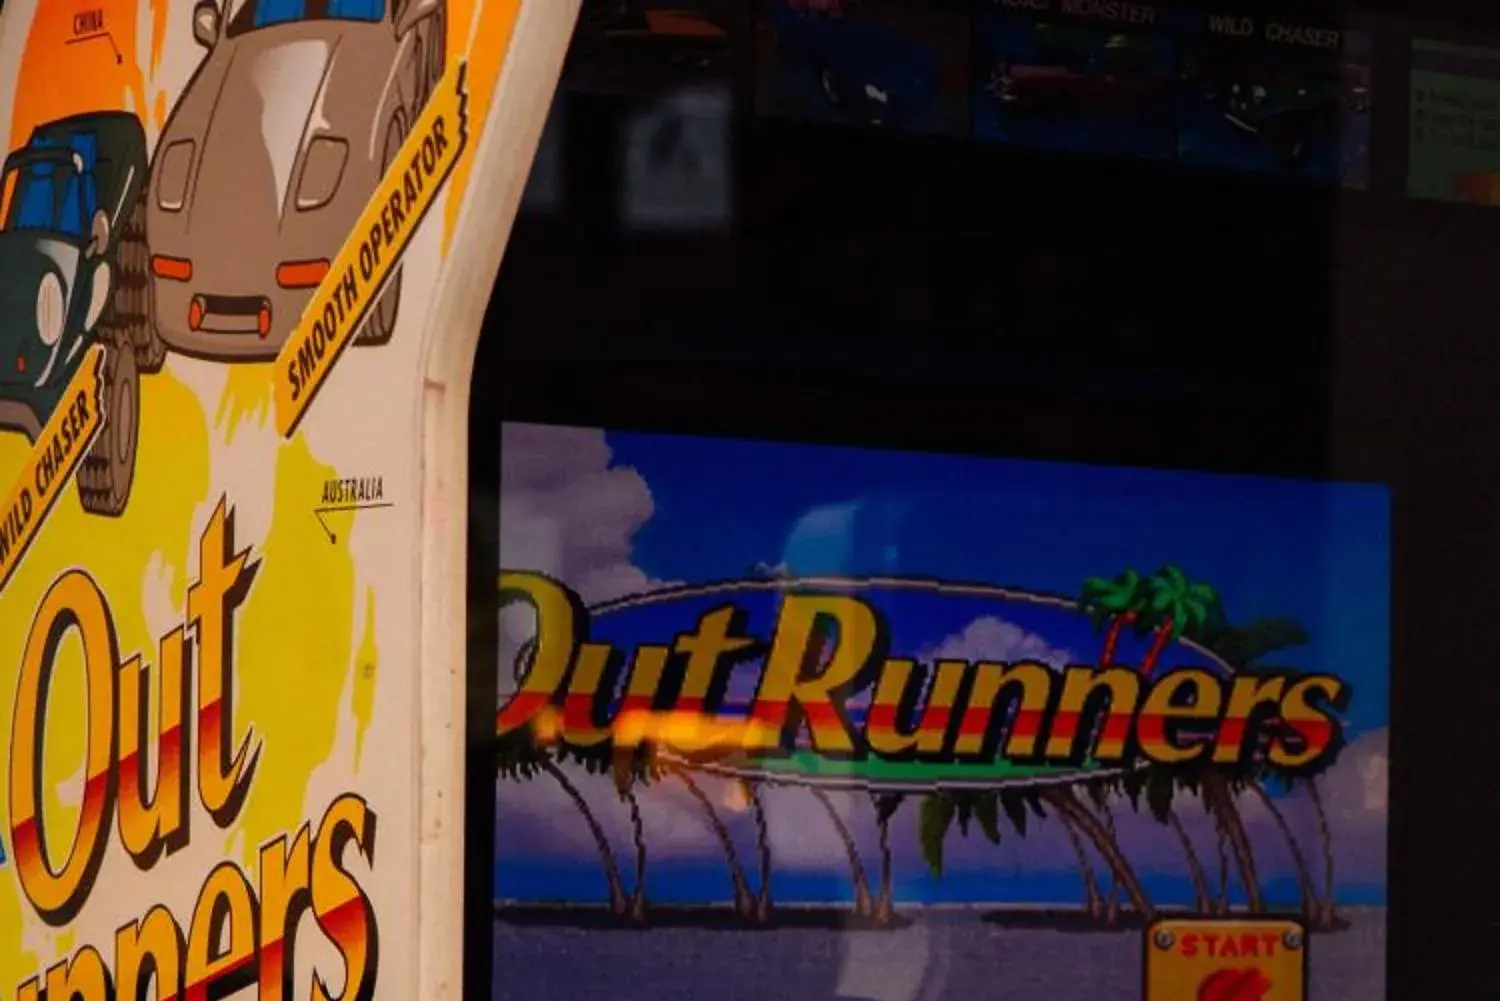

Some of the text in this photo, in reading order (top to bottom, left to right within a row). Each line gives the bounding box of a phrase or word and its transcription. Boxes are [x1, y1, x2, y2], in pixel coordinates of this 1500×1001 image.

[1208, 13, 1342, 50] WILD CHASER
[286, 115, 450, 402] SMOOTH OPERATOR
[34, 388, 90, 497] CHASER
[321, 476, 384, 502] AUSTRALIA
[10, 491, 263, 926] Out
[1180, 931, 1280, 959] START
